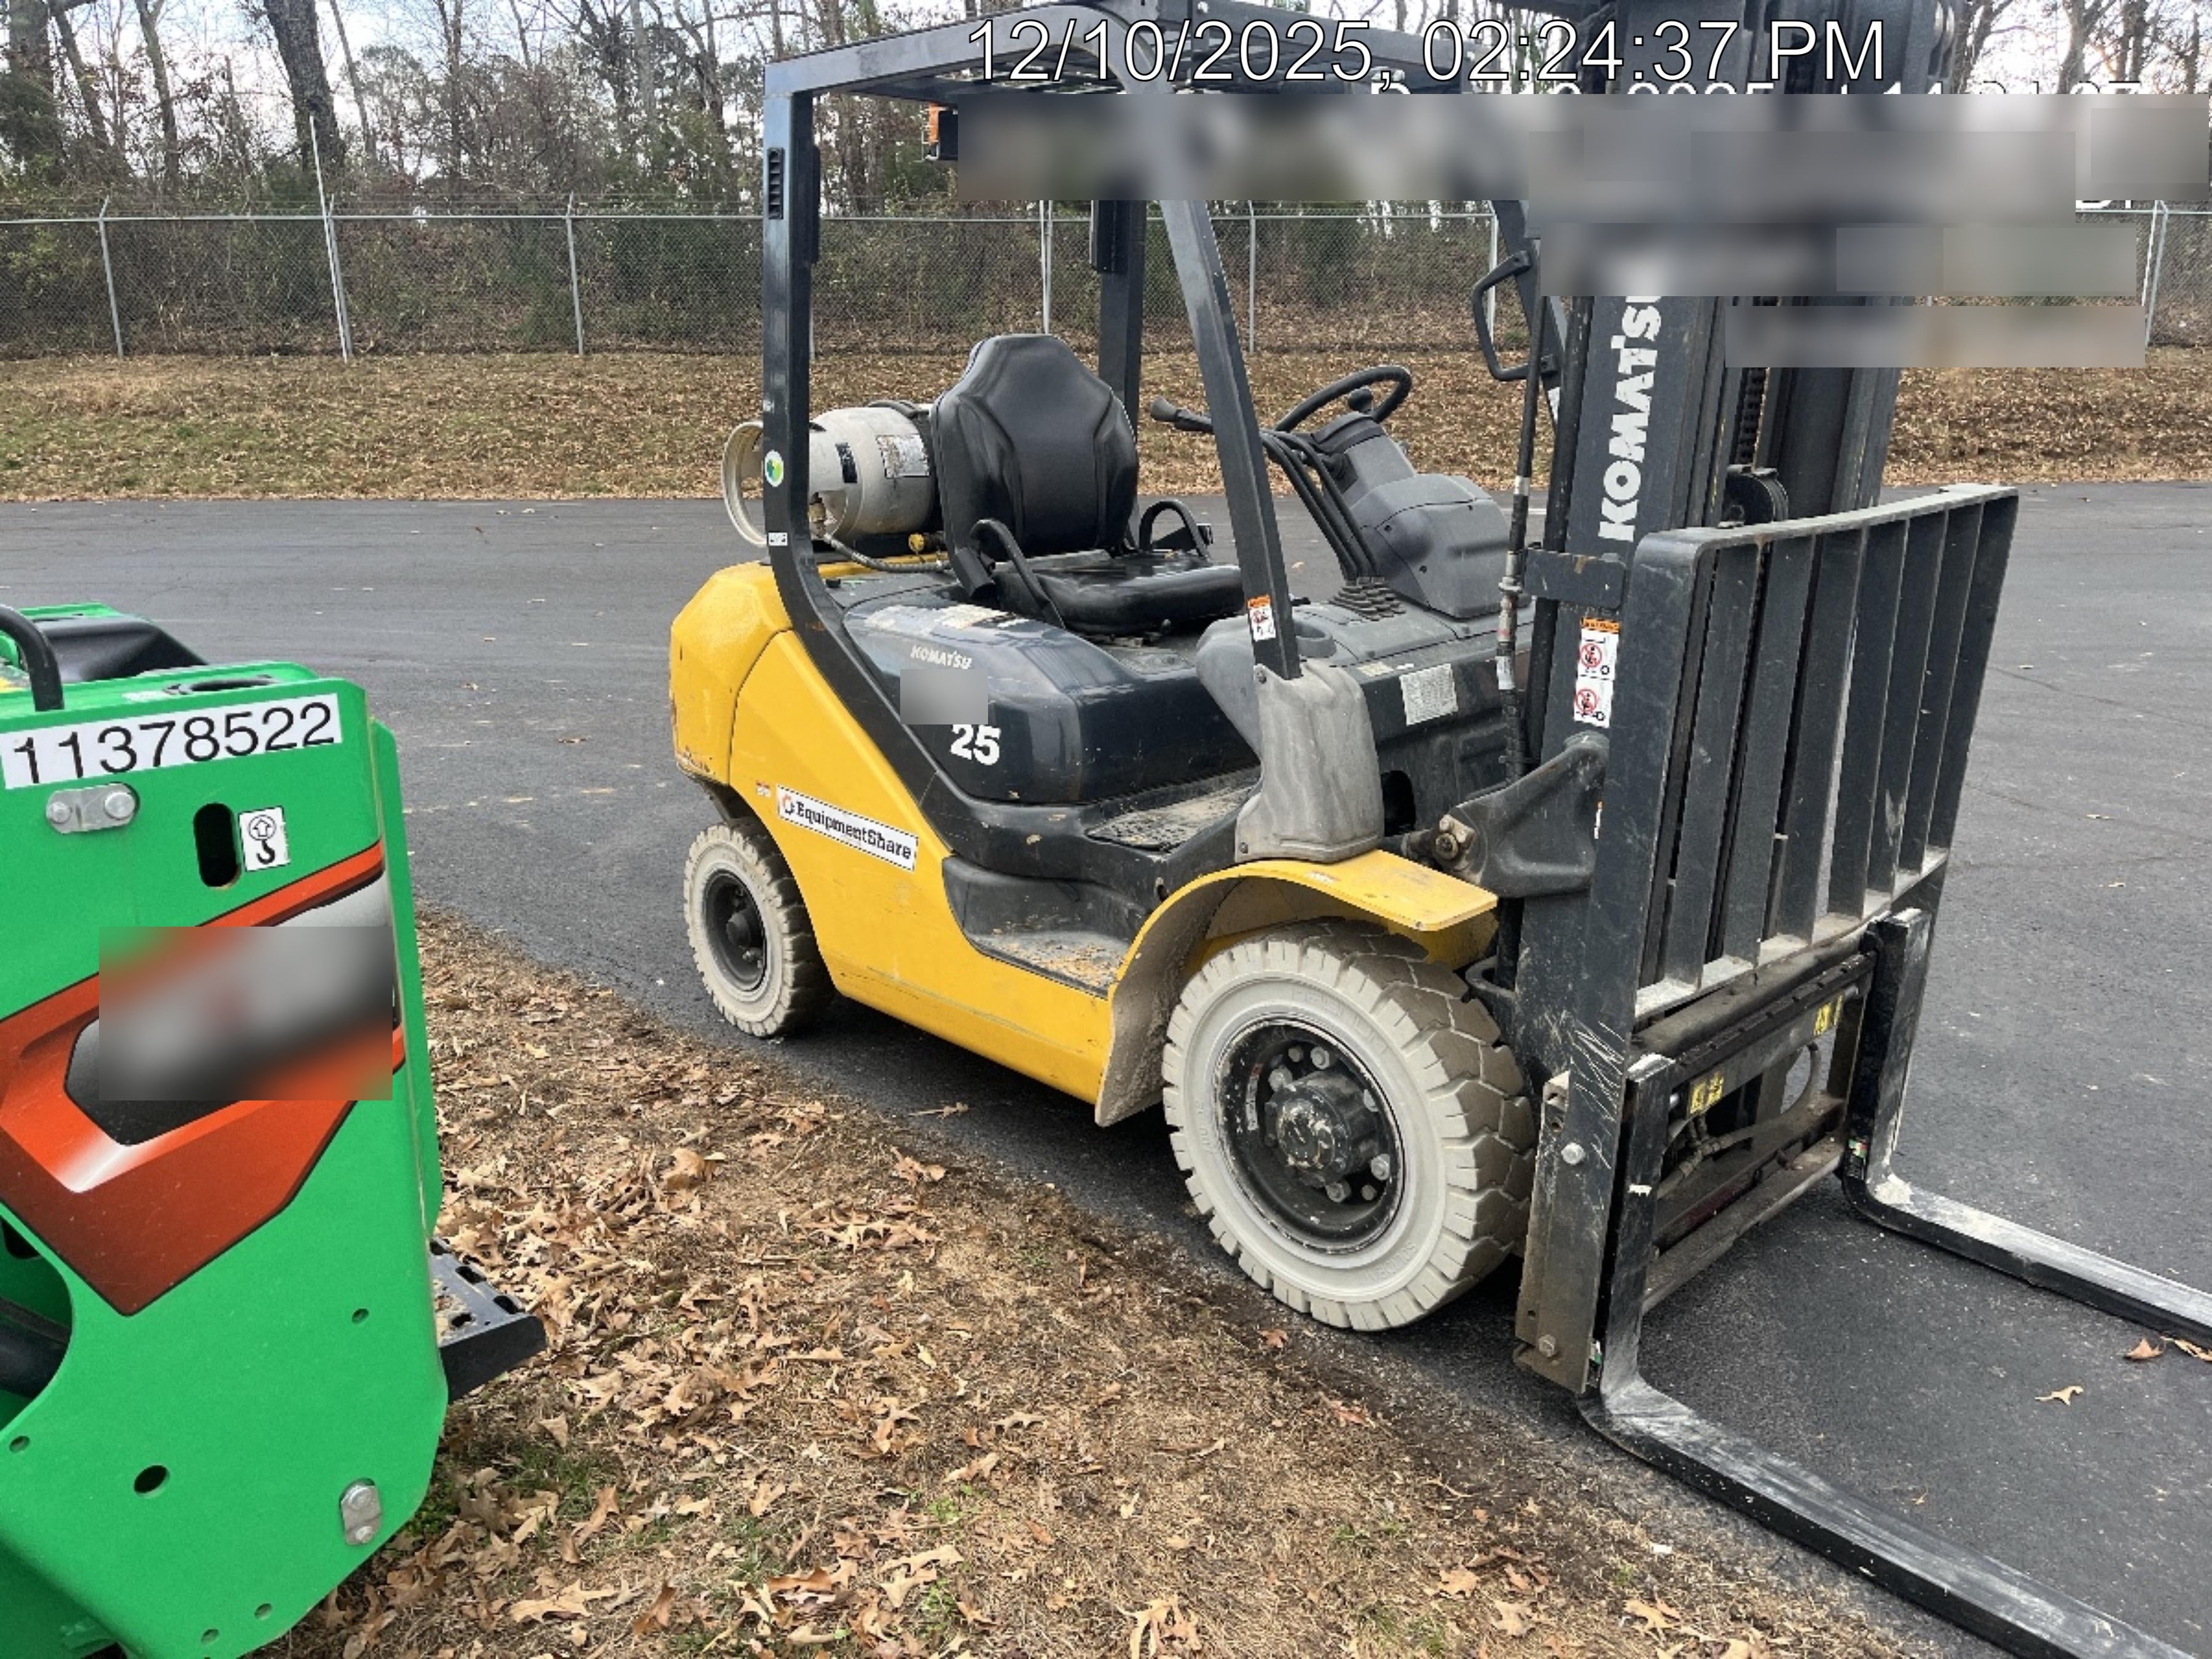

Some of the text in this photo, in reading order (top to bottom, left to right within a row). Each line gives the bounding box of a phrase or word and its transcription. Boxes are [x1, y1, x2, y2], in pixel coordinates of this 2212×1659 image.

[1598, 296, 1661, 542] KOMATS
[910, 645, 973, 670] KOMATSU
[14, 702, 335, 784] 11378522
[950, 724, 1001, 765] 25
[796, 801, 911, 860] EquipmentShare
